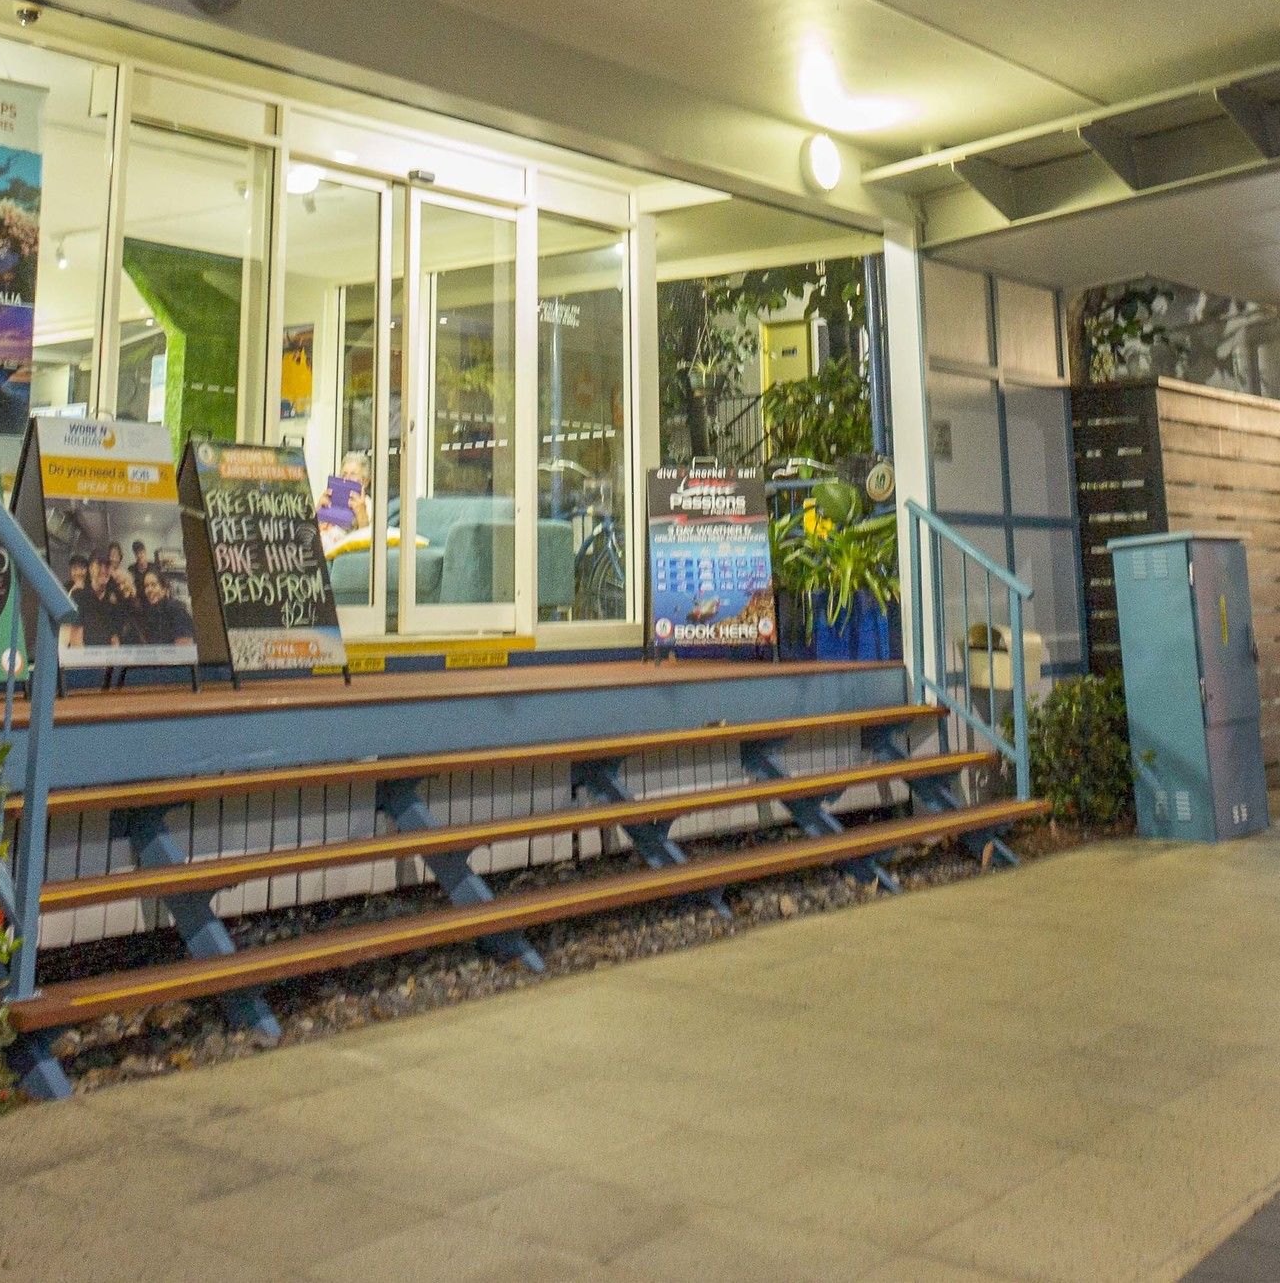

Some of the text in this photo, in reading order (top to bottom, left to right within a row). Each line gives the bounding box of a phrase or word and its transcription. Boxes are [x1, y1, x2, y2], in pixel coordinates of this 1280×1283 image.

[69, 424, 97, 437] WORK
[63, 435, 103, 448] HOLIDAY
[48, 464, 64, 475] Do
[67, 467, 87, 478] you
[89, 468, 116, 479] need
[657, 467, 757, 479] dive snorkel sail
[206, 489, 246, 518] FREE
[669, 493, 746, 511] Passions
[211, 517, 294, 543] FREE WIFI
[216, 542, 319, 575] BIKE HIRE
[221, 568, 326, 606] BEDS FROM
[674, 624, 758, 639] BOOK HERE
